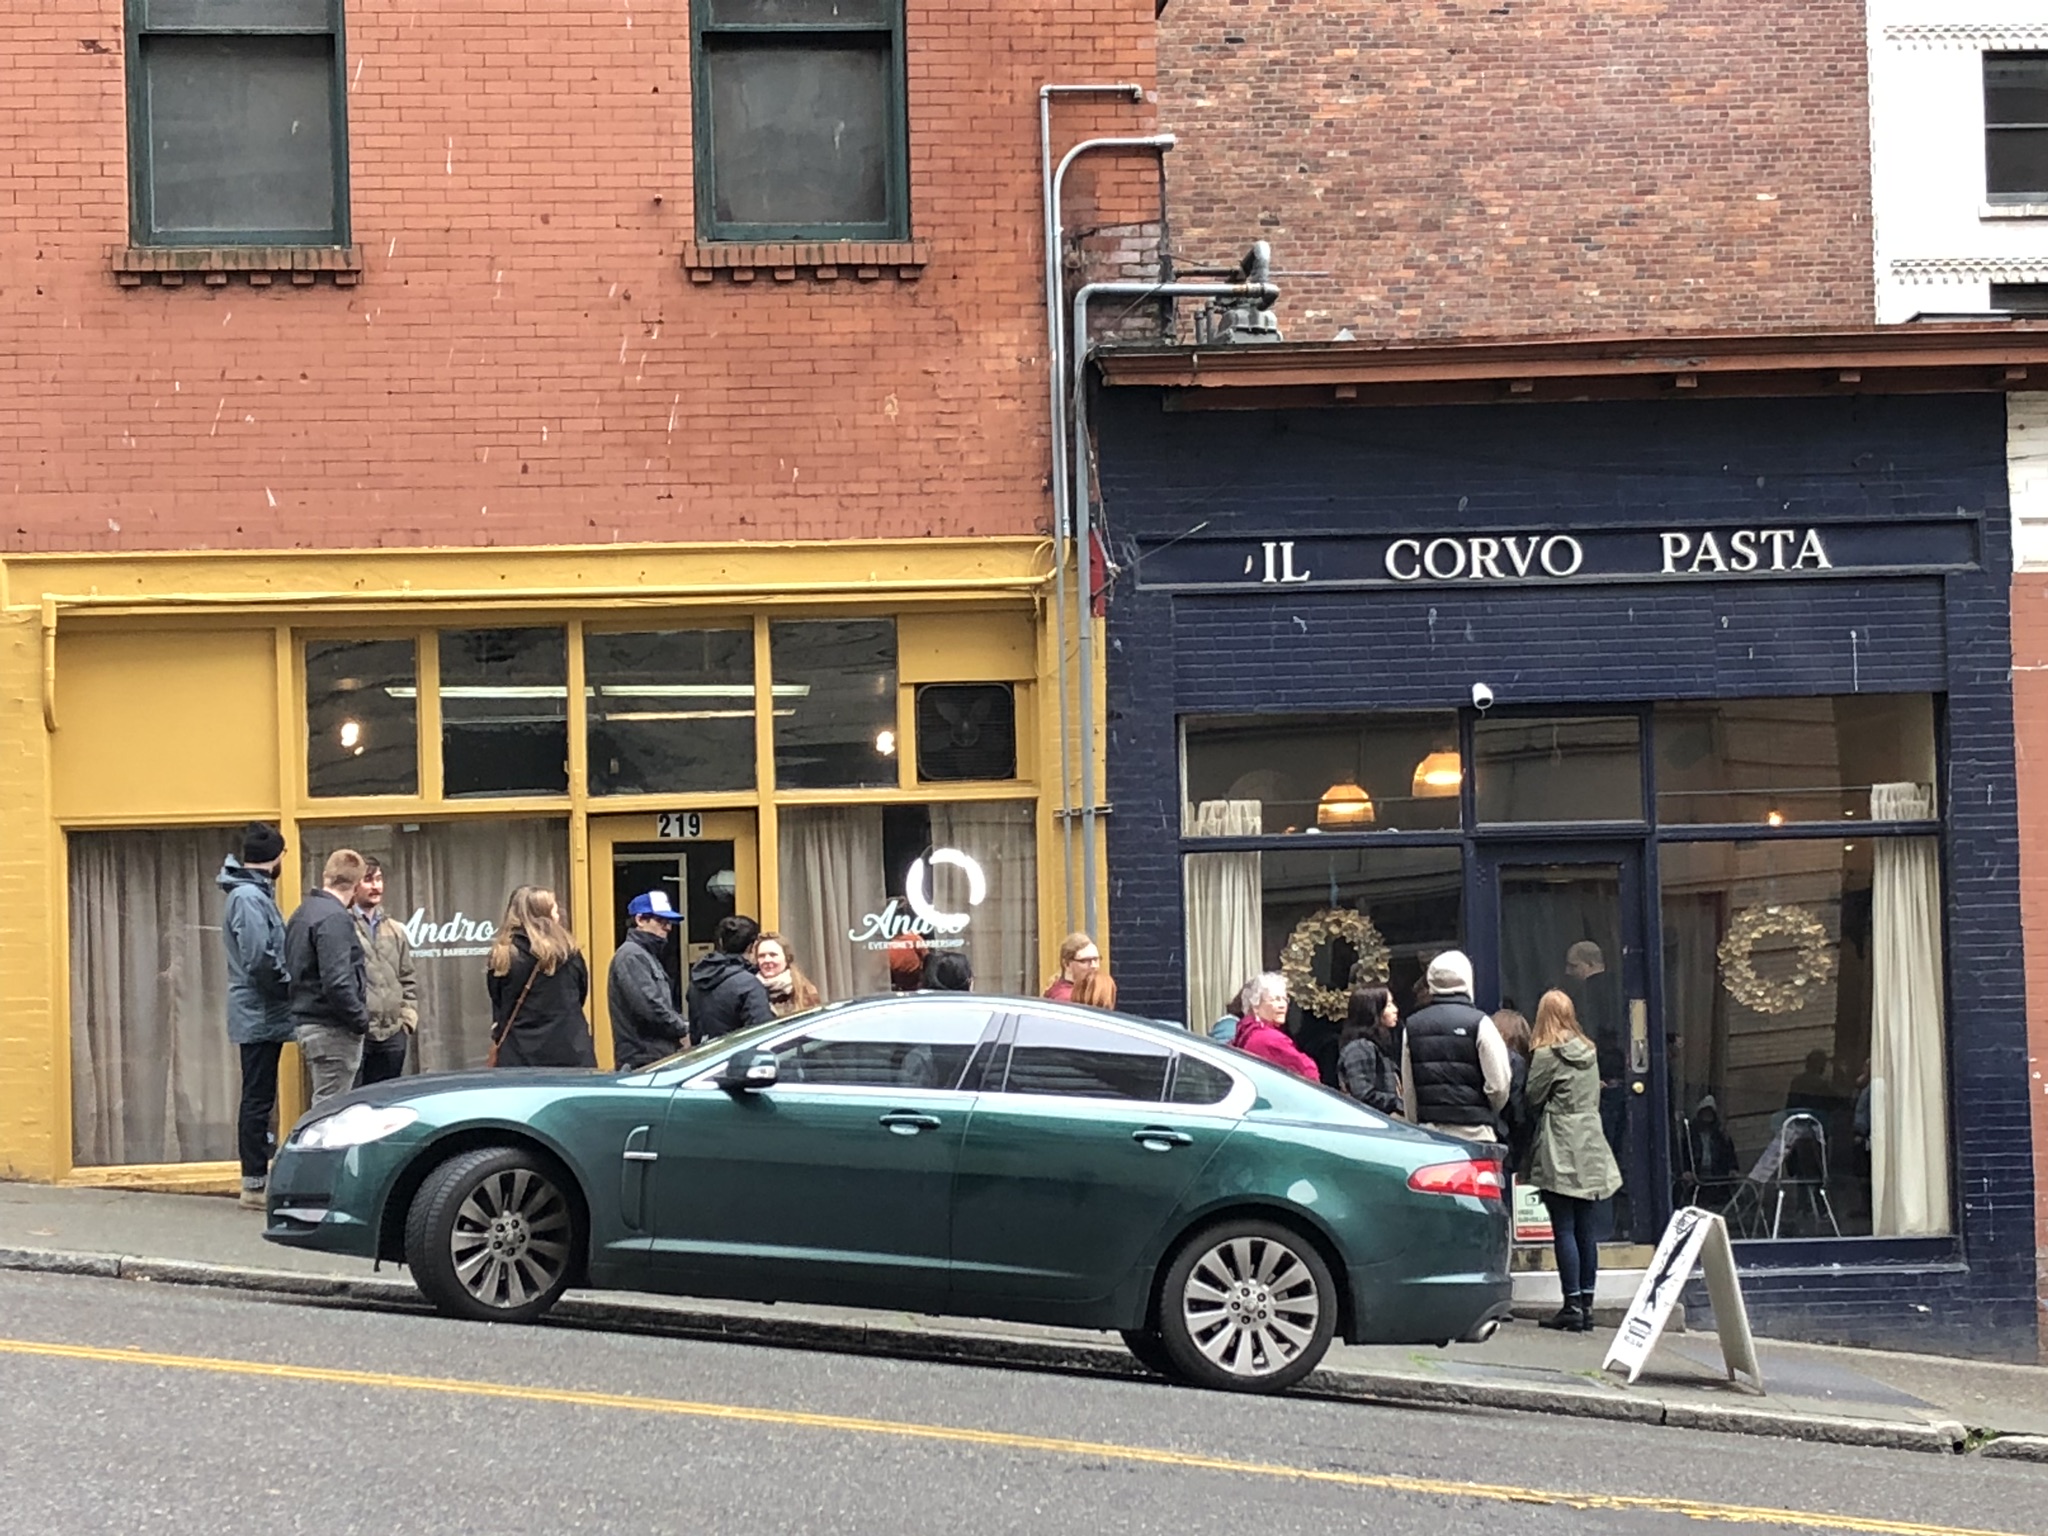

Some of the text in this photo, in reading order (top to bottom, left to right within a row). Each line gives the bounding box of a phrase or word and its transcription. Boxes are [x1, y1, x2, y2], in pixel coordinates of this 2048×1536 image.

[1261, 528, 1833, 583] IL CORVO PASTA
[658, 813, 701, 837] 219
[404, 907, 499, 948] Andro
